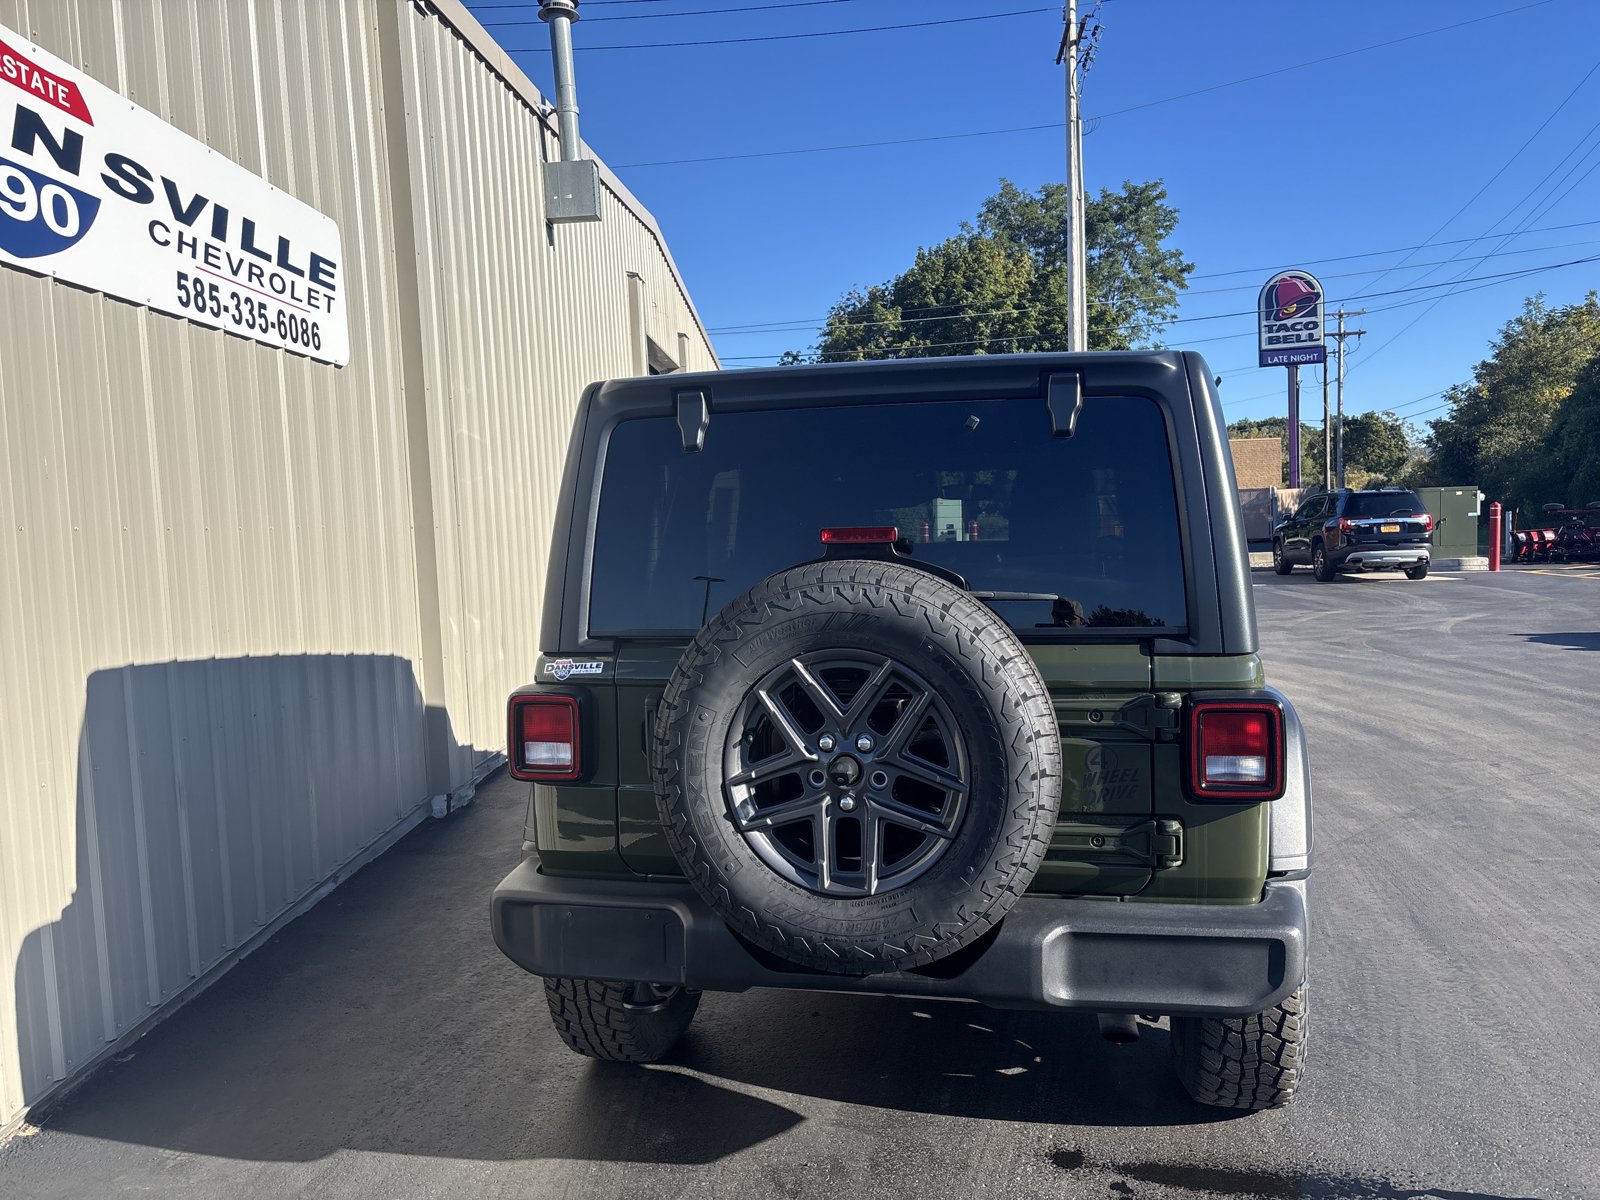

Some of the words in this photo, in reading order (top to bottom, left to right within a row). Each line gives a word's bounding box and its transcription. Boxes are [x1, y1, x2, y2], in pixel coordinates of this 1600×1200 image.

[0, 53, 71, 109] STATE
[148, 219, 336, 314] CHEVROLET
[176, 270, 322, 351] 585-335-6086
[1264, 321, 1320, 333] TACO
[1267, 333, 1321, 345] BELL
[1267, 356, 1288, 364] LATE
[1290, 353, 1318, 363] NIGHT
[545, 663, 602, 672] DANSVILLE
[688, 724, 731, 862] NEXEN
